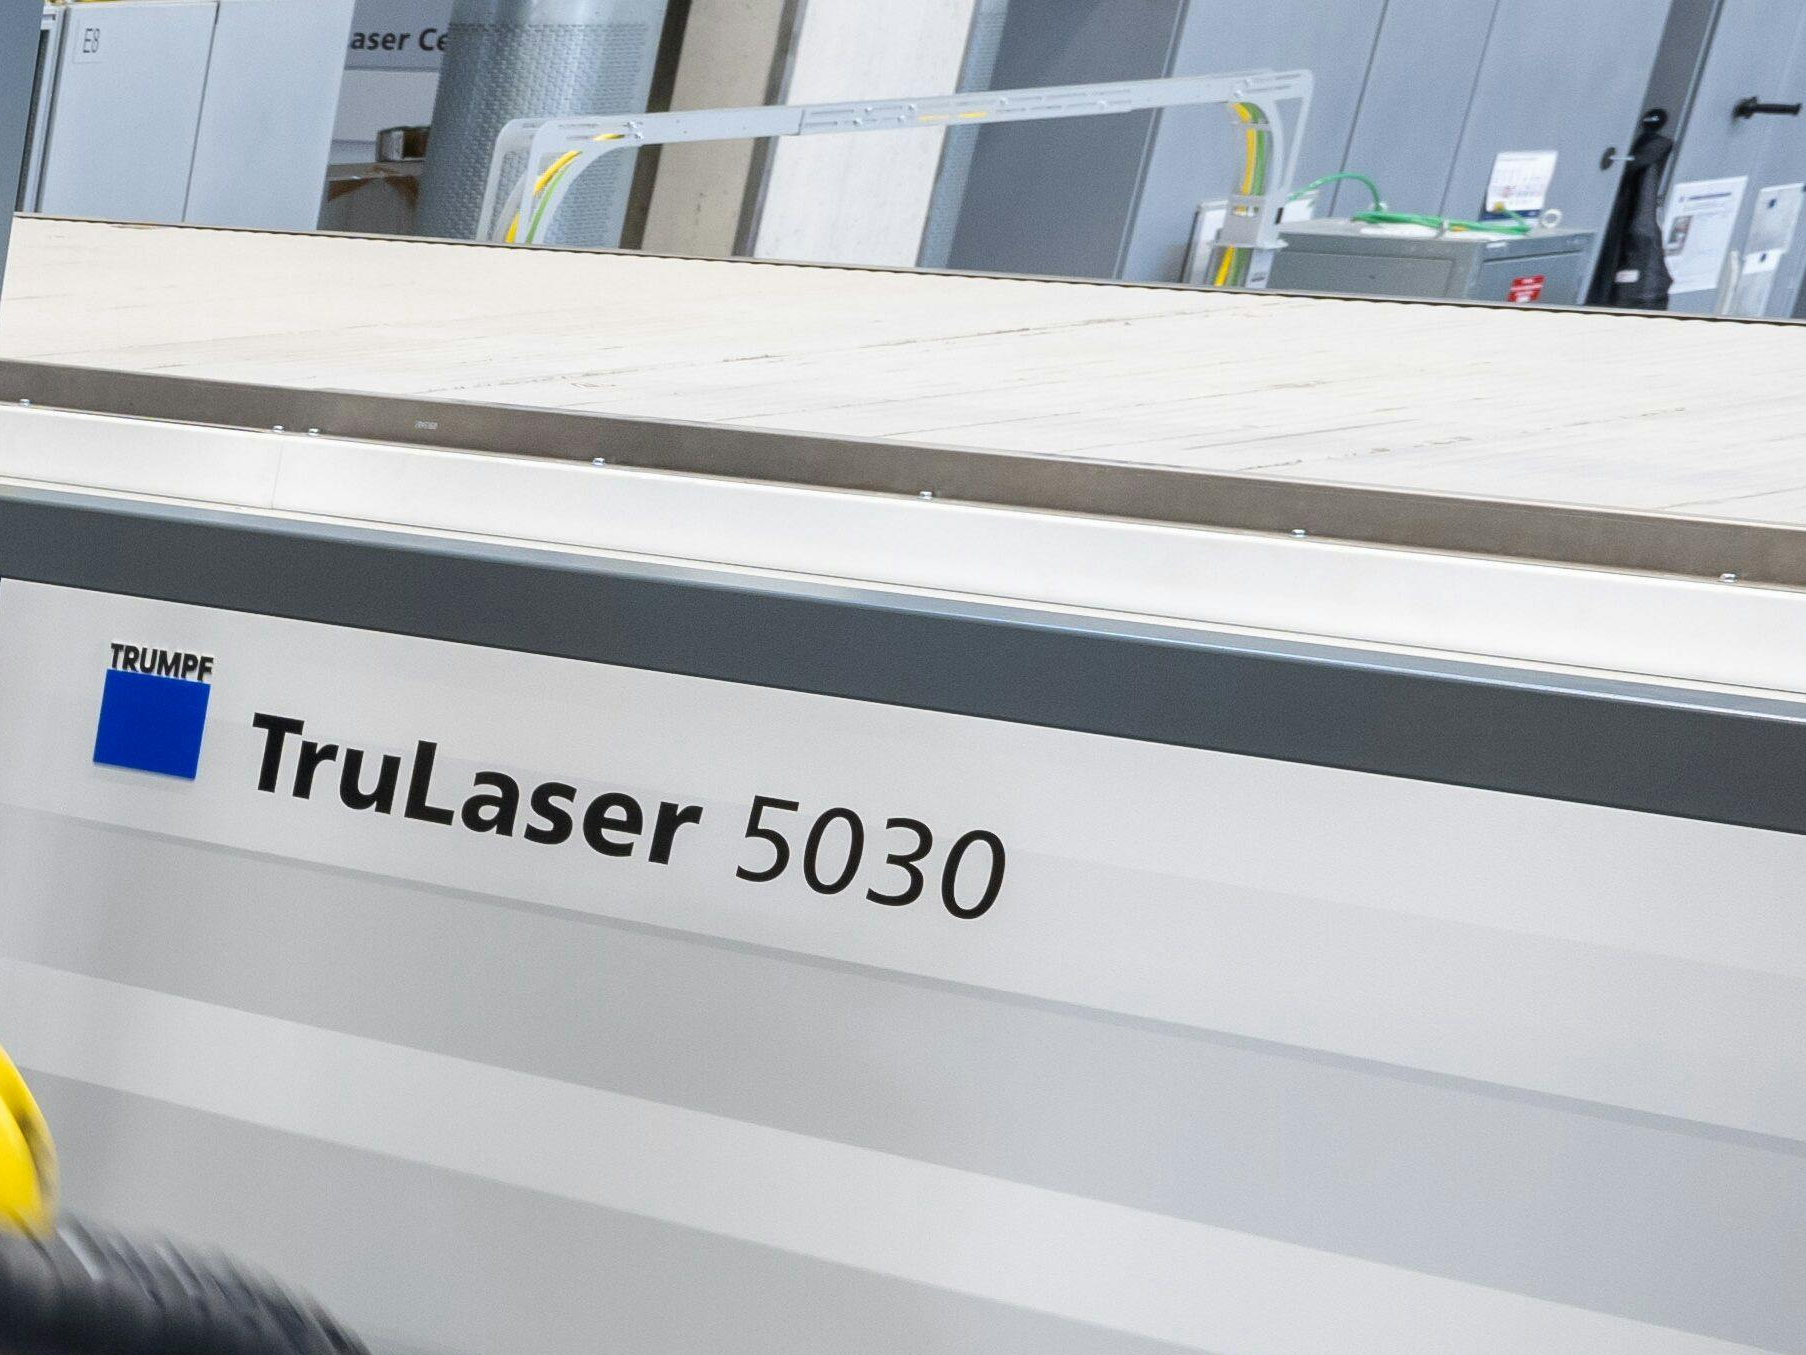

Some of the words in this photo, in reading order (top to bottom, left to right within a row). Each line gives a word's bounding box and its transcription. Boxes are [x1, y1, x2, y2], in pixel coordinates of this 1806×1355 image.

[83, 28, 100, 53] E8
[350, 32, 411, 51] aser
[419, 28, 449, 51] Ce
[110, 642, 214, 682] TRUMPF
[251, 712, 702, 865] TruLaser
[736, 794, 1006, 919] 5030
